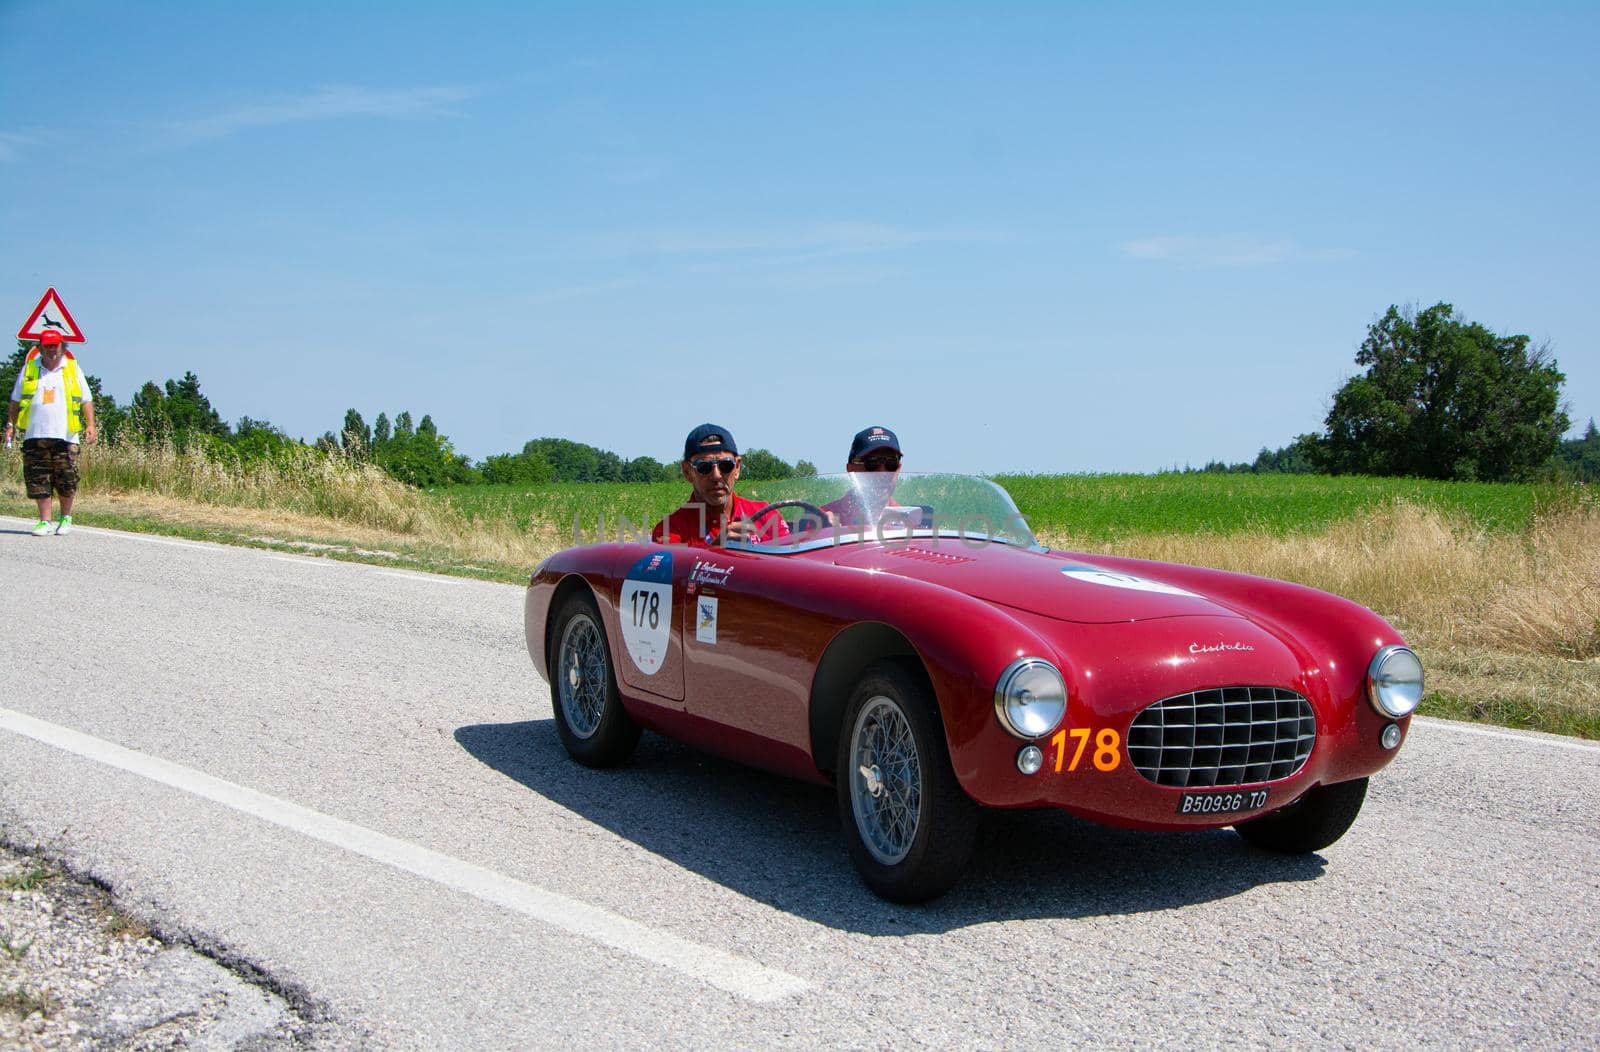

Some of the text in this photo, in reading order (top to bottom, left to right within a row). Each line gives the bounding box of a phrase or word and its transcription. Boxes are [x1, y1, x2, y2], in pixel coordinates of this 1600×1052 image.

[631, 590, 660, 630] 178
[1188, 641, 1255, 654] Cisitalia
[1052, 728, 1121, 772] 178
[1182, 794, 1242, 813] B50936
